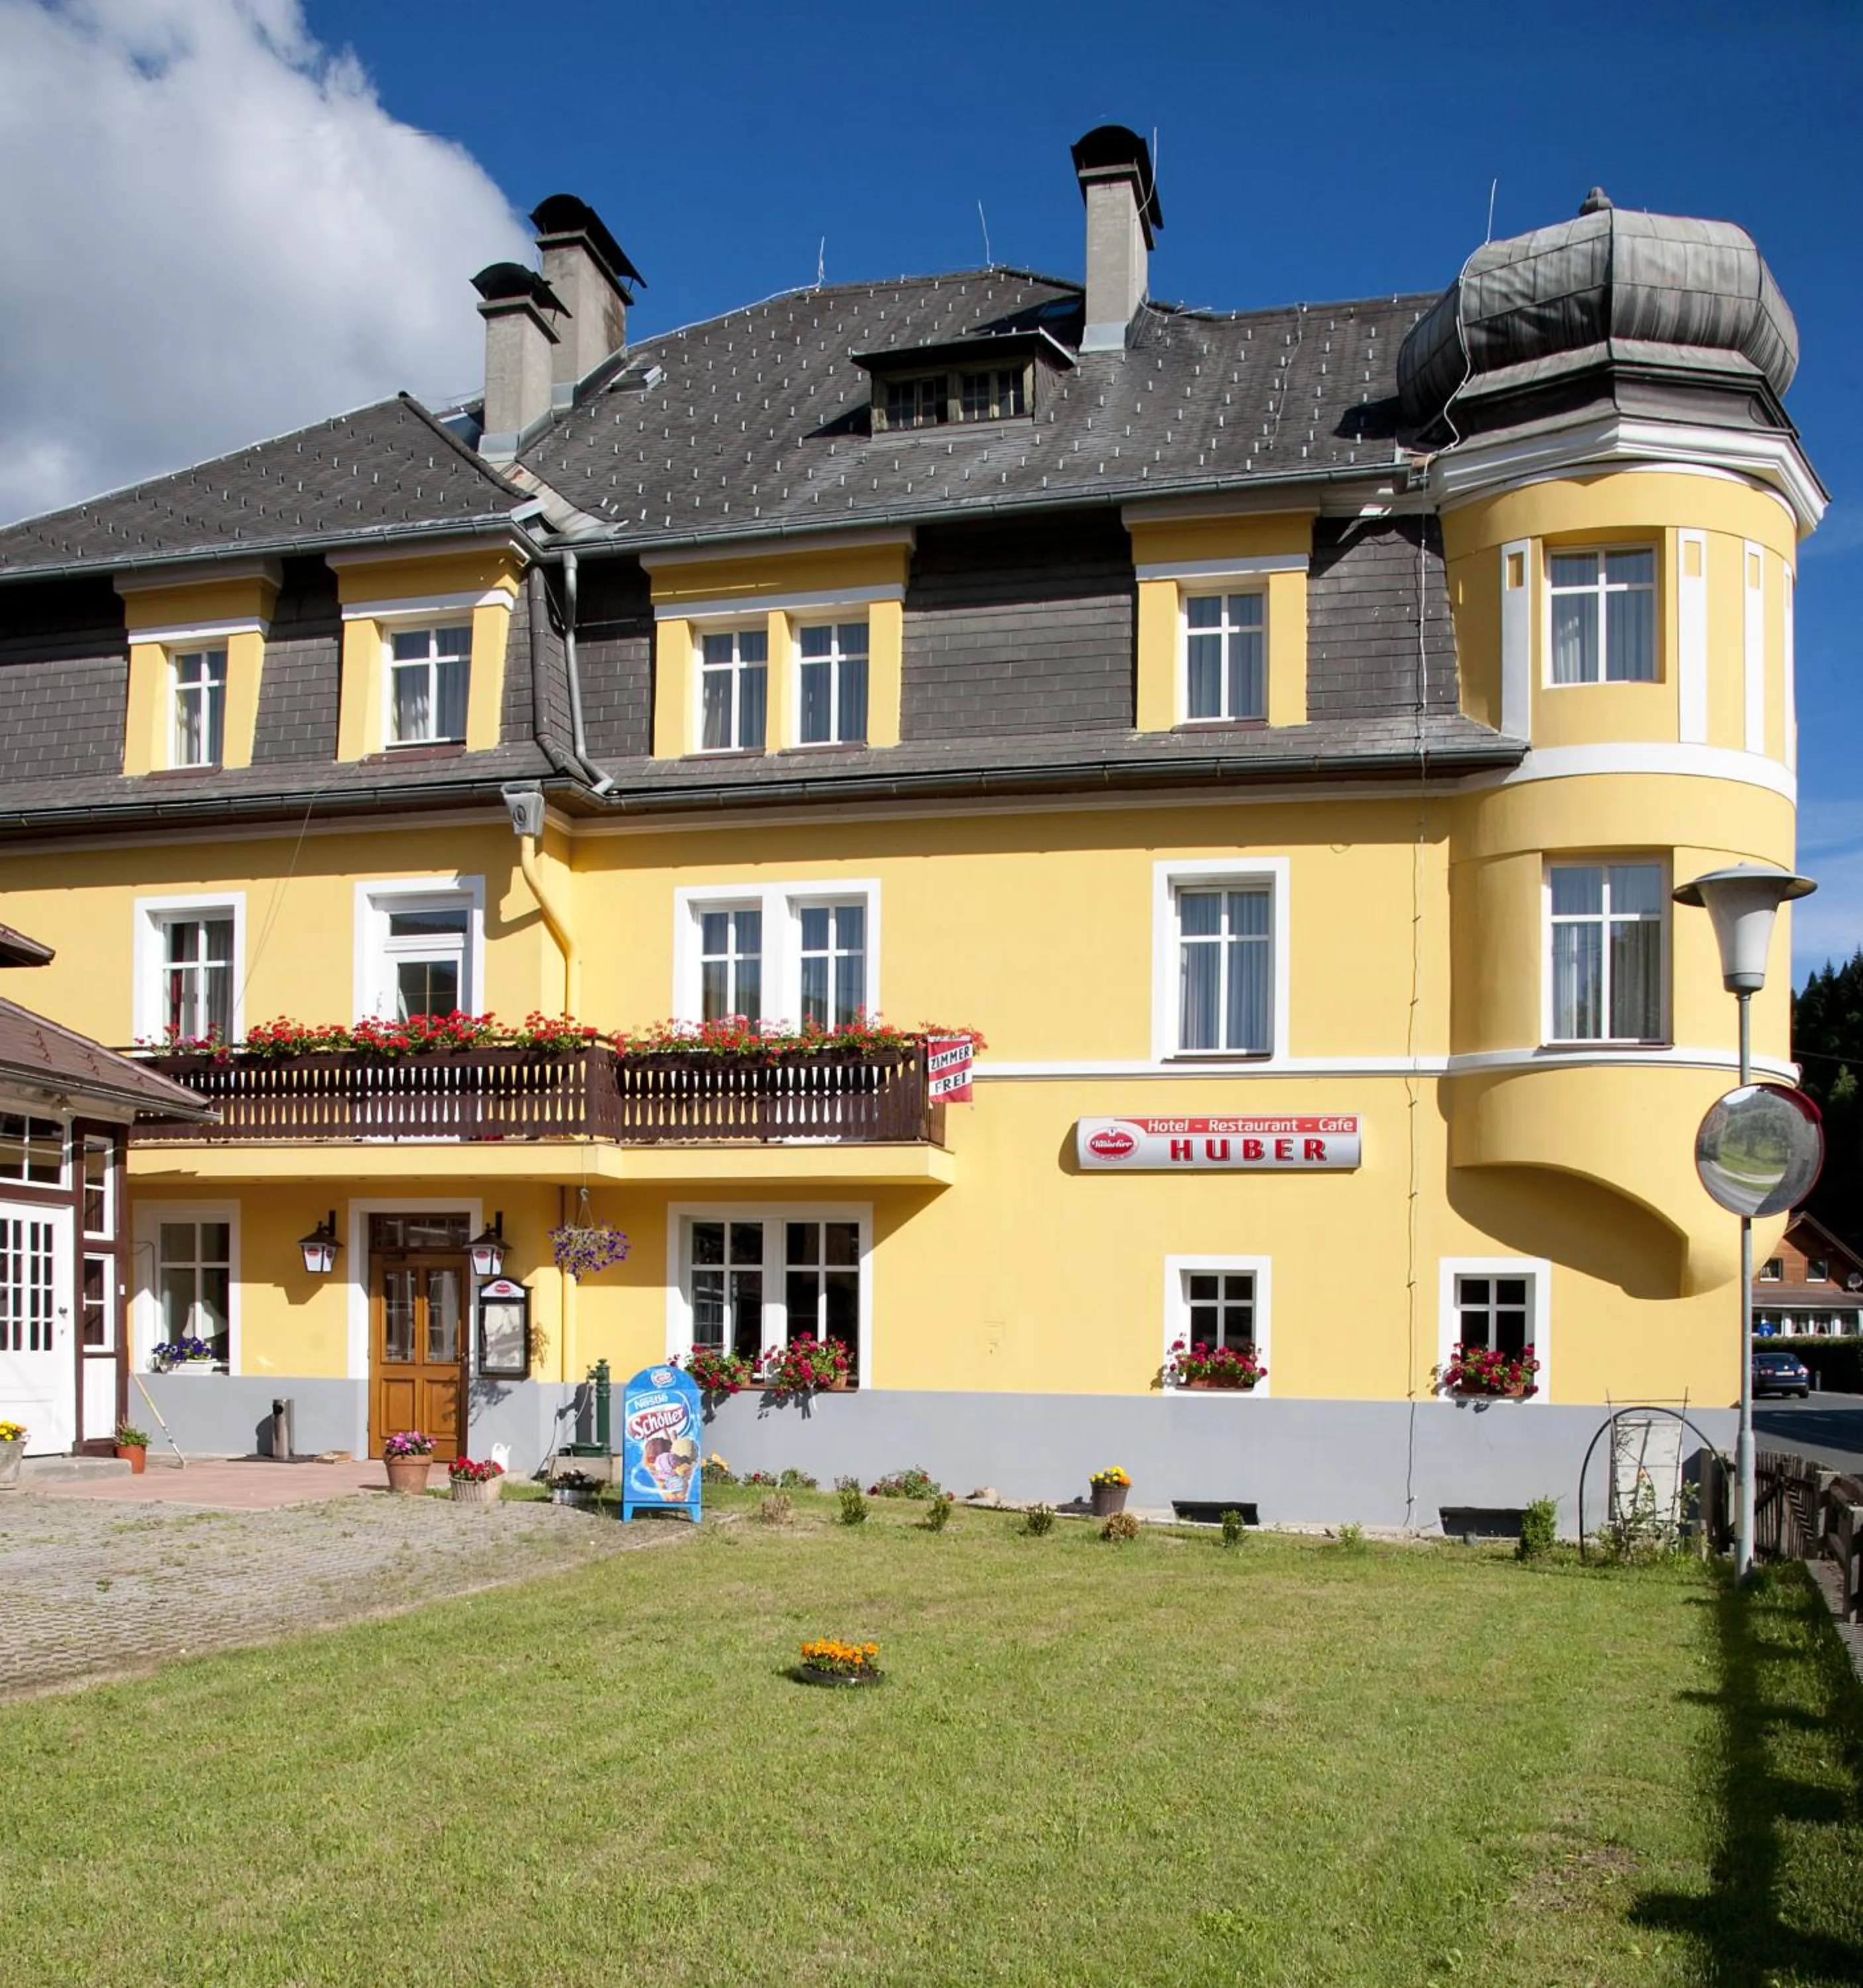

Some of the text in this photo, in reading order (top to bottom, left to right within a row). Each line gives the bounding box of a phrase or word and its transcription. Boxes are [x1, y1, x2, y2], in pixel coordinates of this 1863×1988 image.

[930, 1046, 970, 1070] ZIMMER
[935, 1072, 965, 1093] FREI
[1147, 1119, 1189, 1132] Hotel
[1208, 1119, 1299, 1132] Restaurant
[1318, 1118, 1354, 1131] Cafe
[1170, 1138, 1327, 1161] HUBER
[631, 1408, 685, 1440] Schöller
